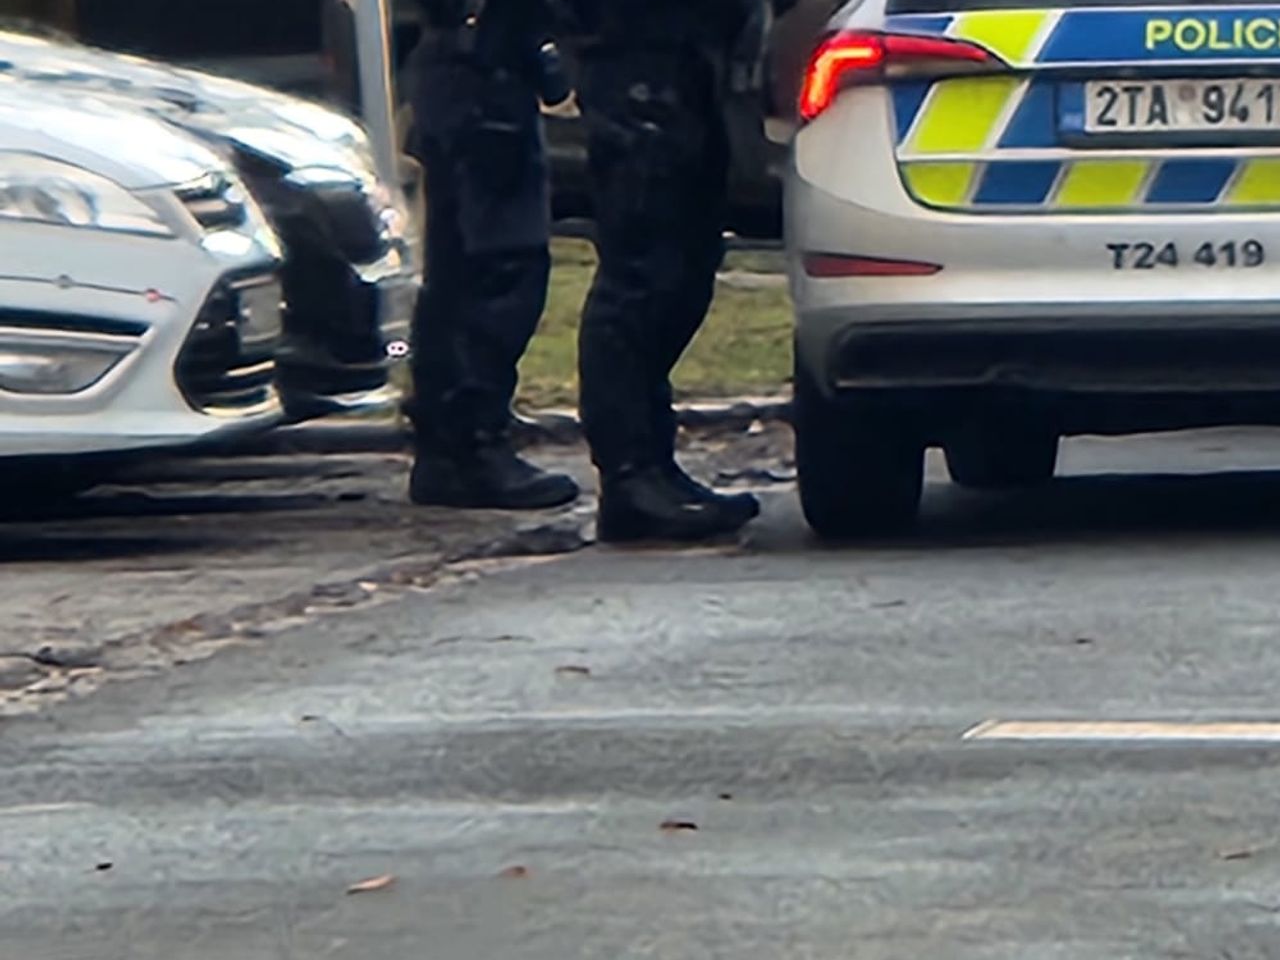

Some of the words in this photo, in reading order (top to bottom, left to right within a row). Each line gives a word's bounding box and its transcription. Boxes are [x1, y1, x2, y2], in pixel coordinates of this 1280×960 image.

[1096, 85, 1168, 126] 2TA
[1106, 242, 1178, 269] T24
[1194, 239, 1264, 268] 419
